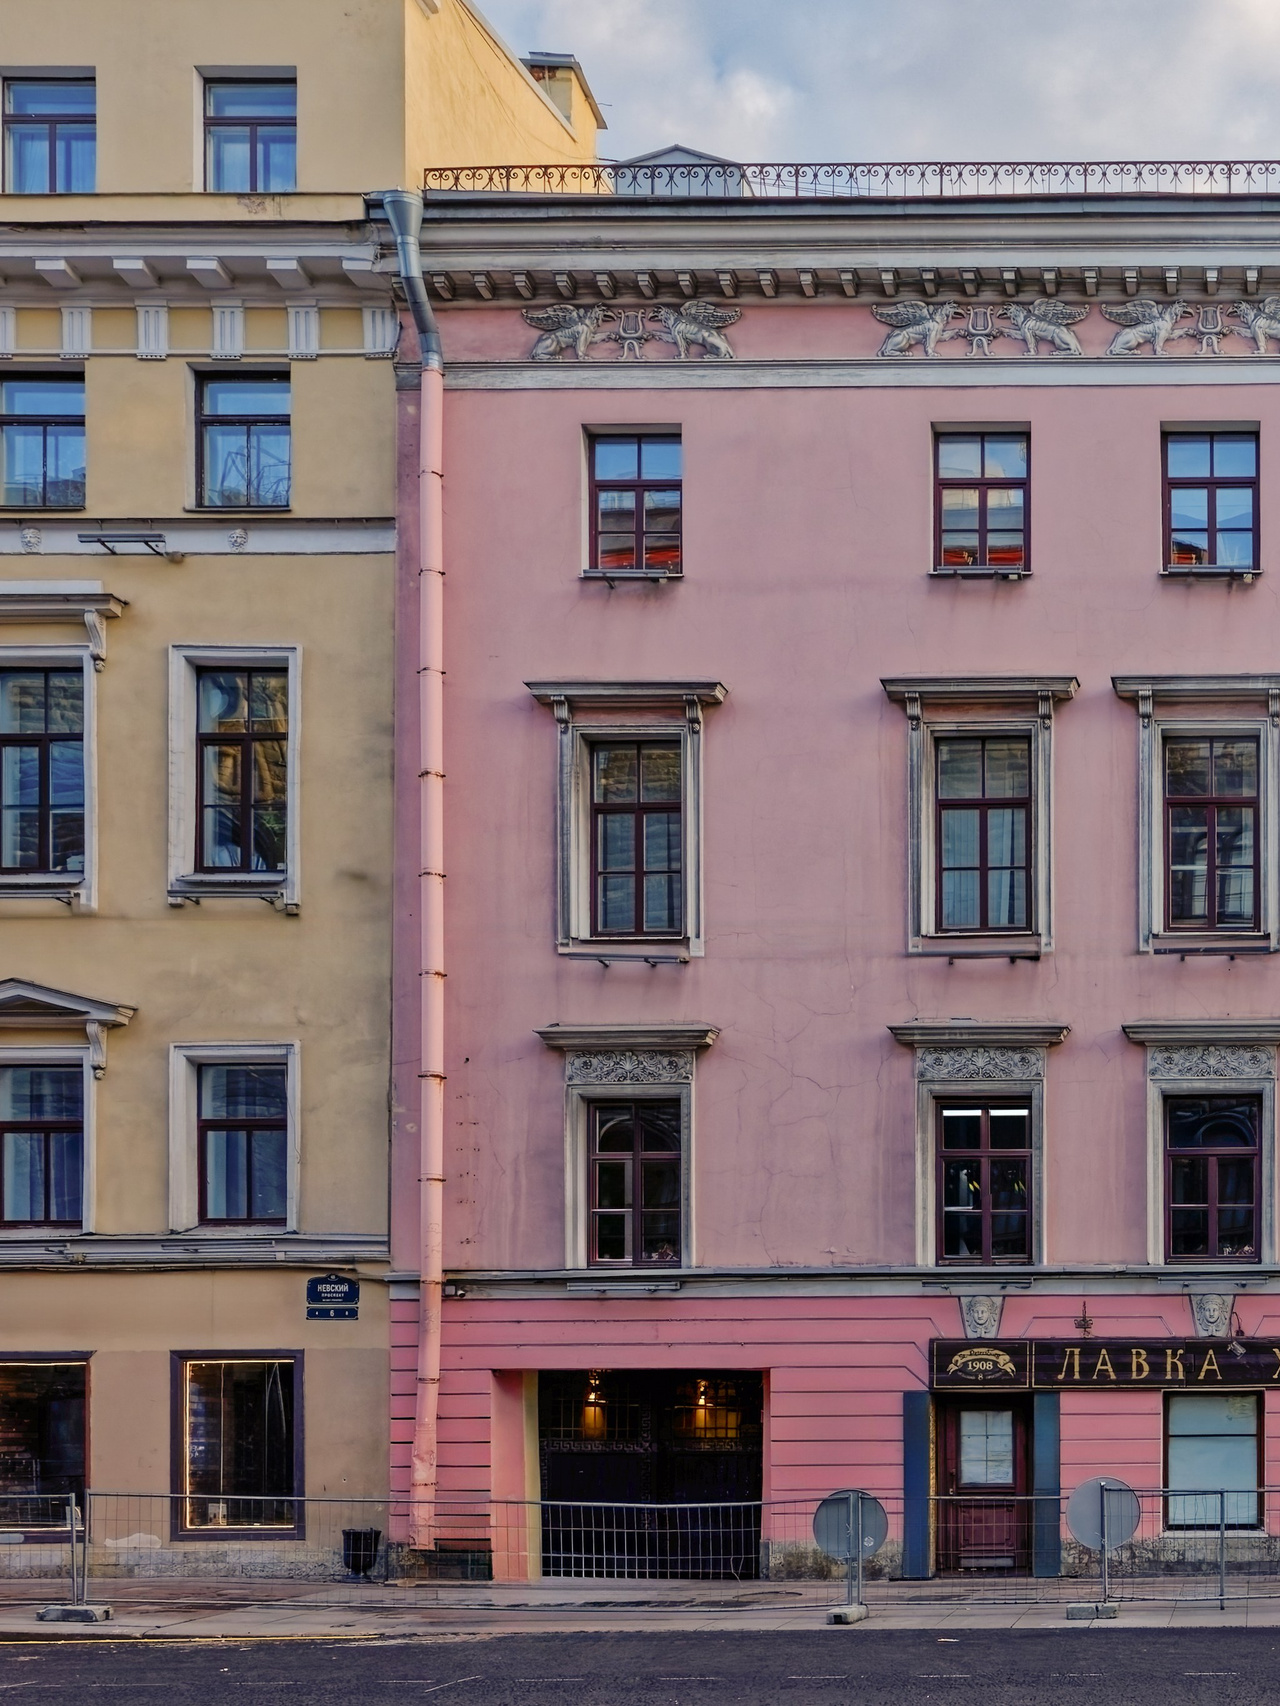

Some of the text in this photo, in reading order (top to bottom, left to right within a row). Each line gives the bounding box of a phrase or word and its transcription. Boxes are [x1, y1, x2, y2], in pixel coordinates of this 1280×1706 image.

[317, 1283, 349, 1292] НЕВСКИЙ
[329, 1309, 335, 1317] 6
[967, 1360, 993, 1372] 1908
[1057, 1348, 1222, 1380] ЛАВКА
